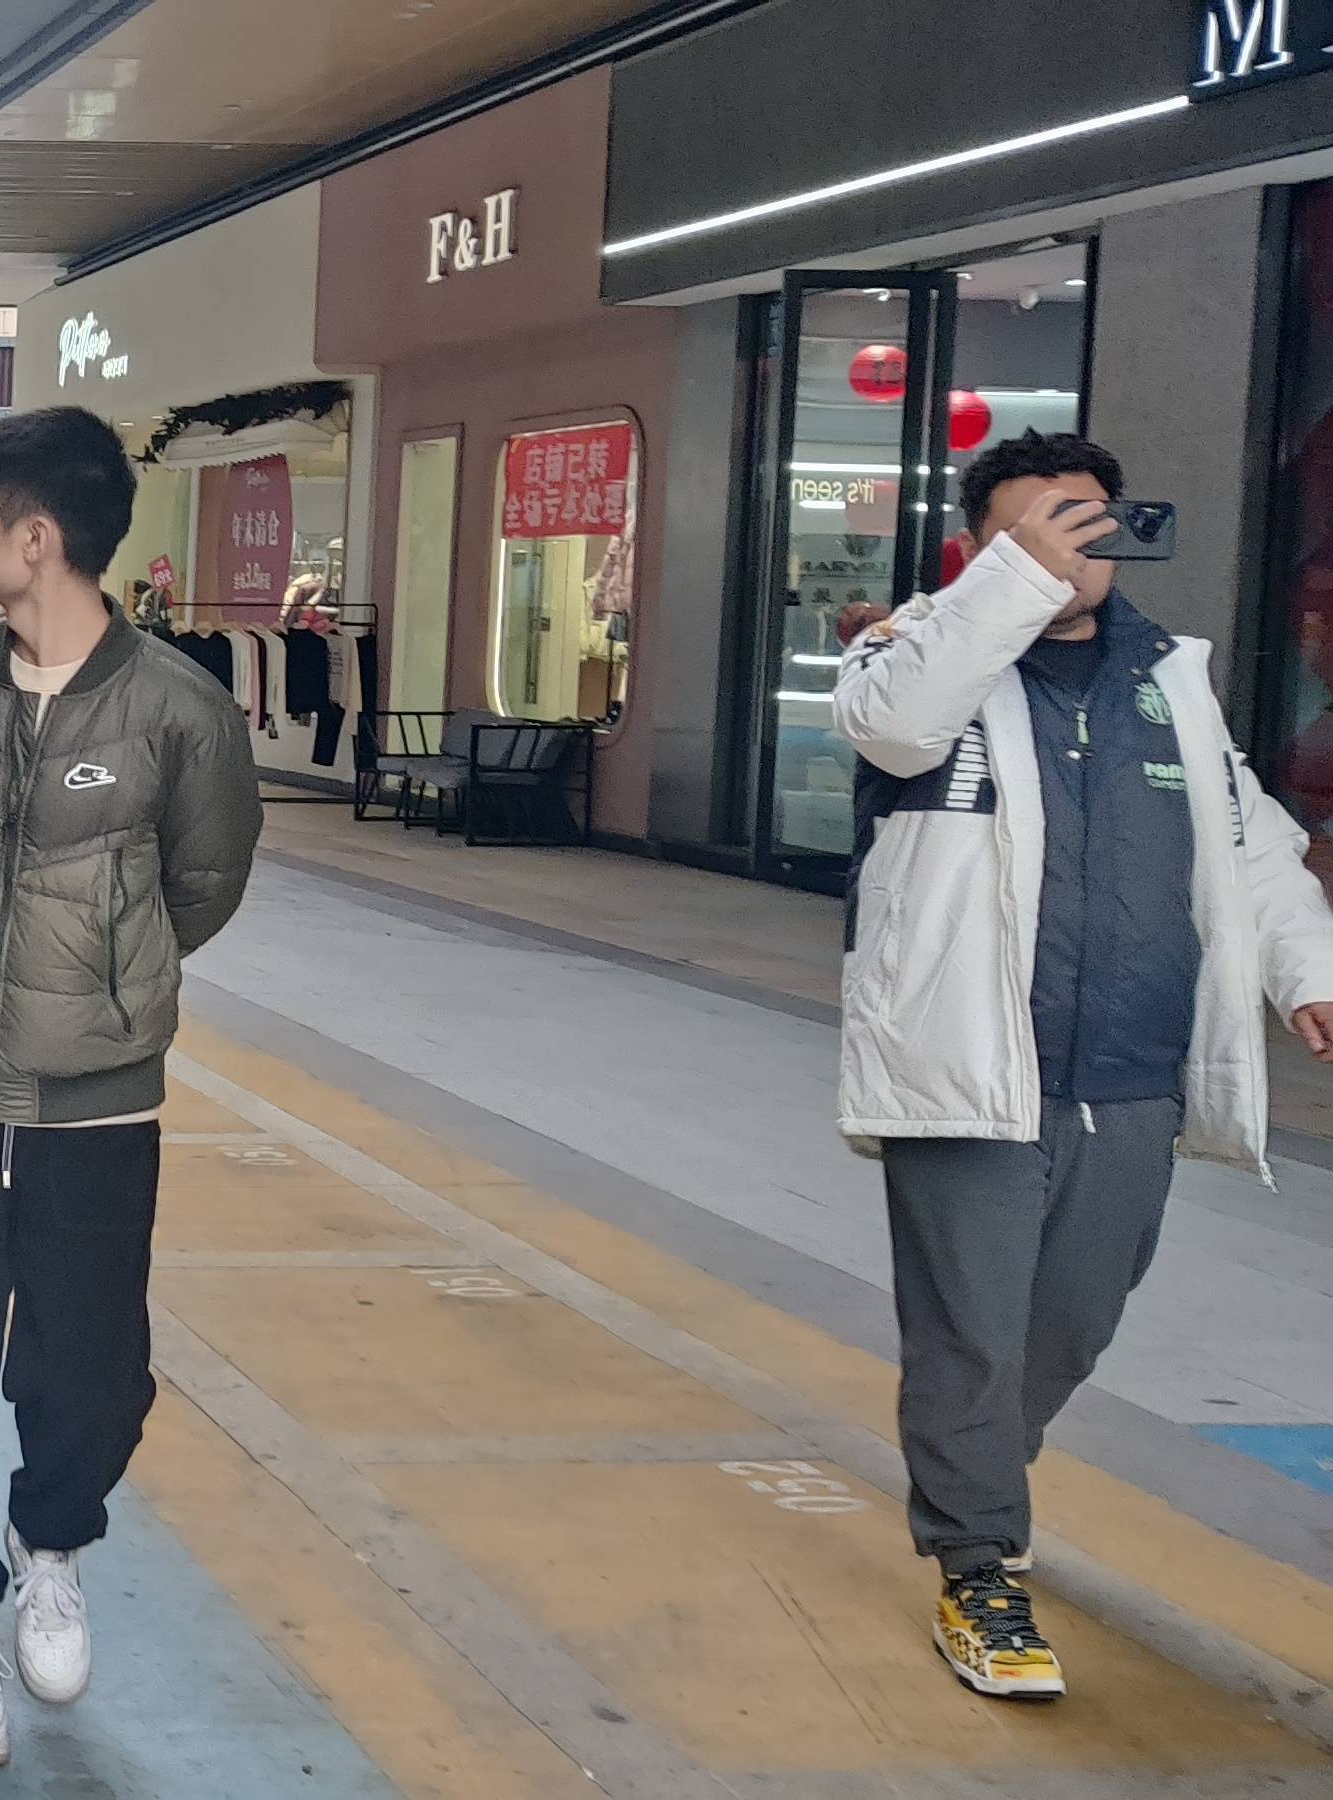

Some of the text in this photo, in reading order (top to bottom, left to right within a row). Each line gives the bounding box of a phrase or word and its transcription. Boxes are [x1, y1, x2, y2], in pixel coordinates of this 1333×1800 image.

[426, 189, 516, 284] F&H
[524, 439, 609, 488] 店铺已转
[504, 482, 625, 529] 全场亏本处理
